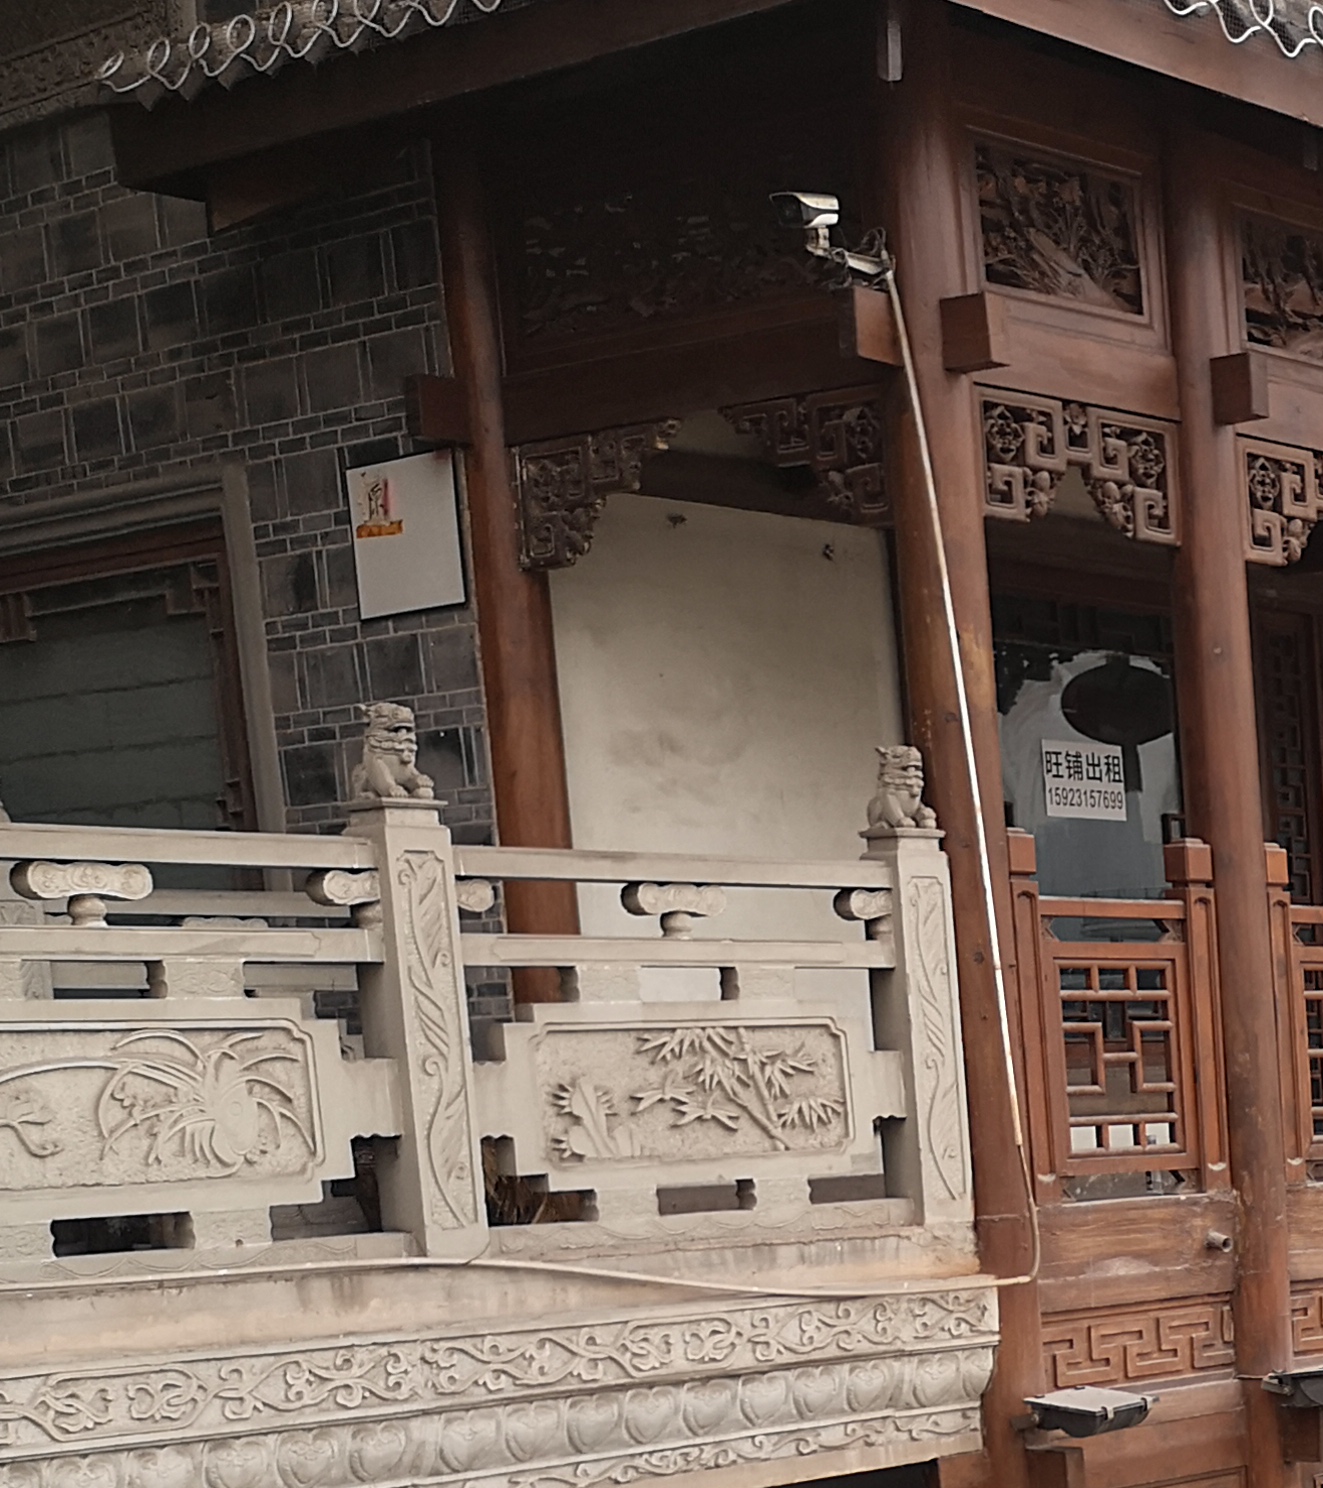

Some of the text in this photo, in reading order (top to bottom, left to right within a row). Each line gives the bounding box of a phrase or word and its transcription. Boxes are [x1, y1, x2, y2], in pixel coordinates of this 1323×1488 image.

[1044, 749, 1123, 784] 旺铺出租
[1048, 787, 1124, 810] 15923157699
